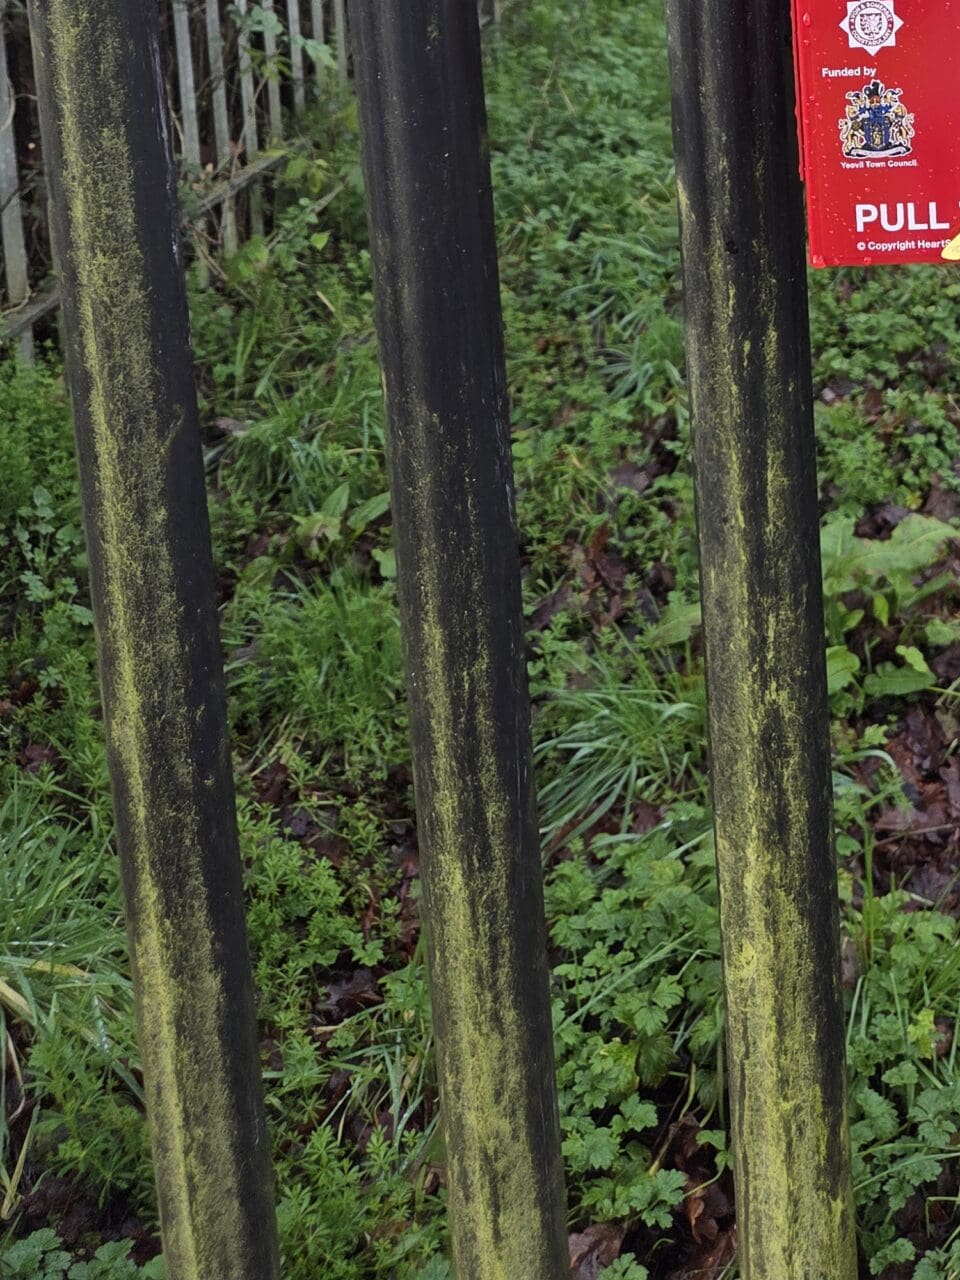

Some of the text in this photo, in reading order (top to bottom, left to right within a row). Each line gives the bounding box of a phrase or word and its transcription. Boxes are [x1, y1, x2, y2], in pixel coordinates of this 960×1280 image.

[821, 65, 877, 78] Funded by
[840, 159, 918, 169] Yeovil Town Council
[856, 202, 949, 232] PULL
[867, 240, 916, 252] Copyright
[917, 240, 954, 250] HeartS
